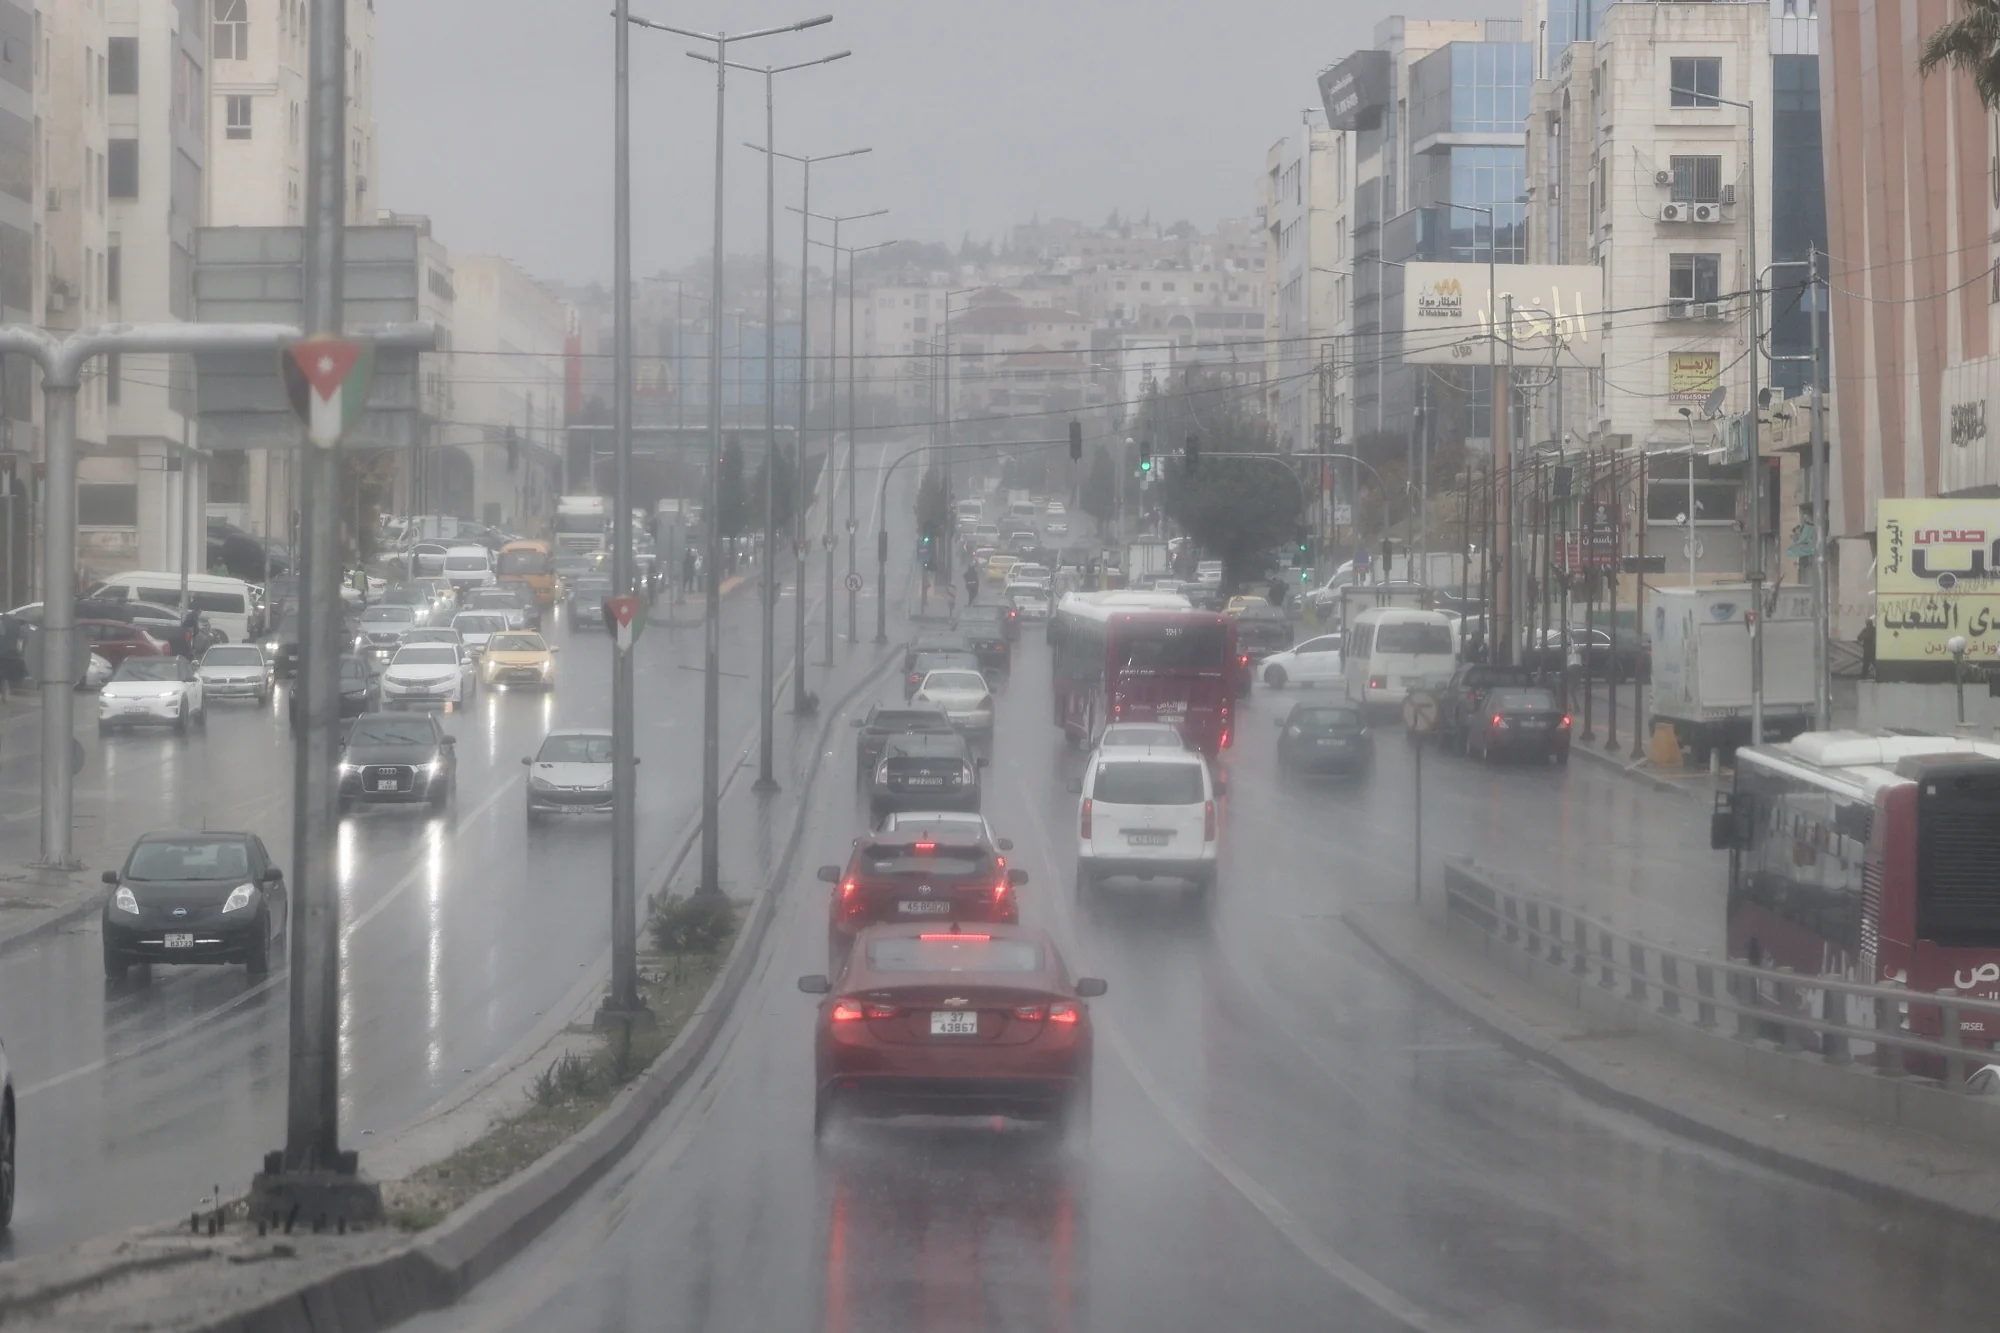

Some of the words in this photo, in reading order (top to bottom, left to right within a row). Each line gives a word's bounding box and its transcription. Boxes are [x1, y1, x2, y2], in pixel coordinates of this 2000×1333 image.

[1884, 519, 1904, 575] اليومية
[951, 1012, 965, 1022] 37
[940, 1022, 975, 1033] 43867
